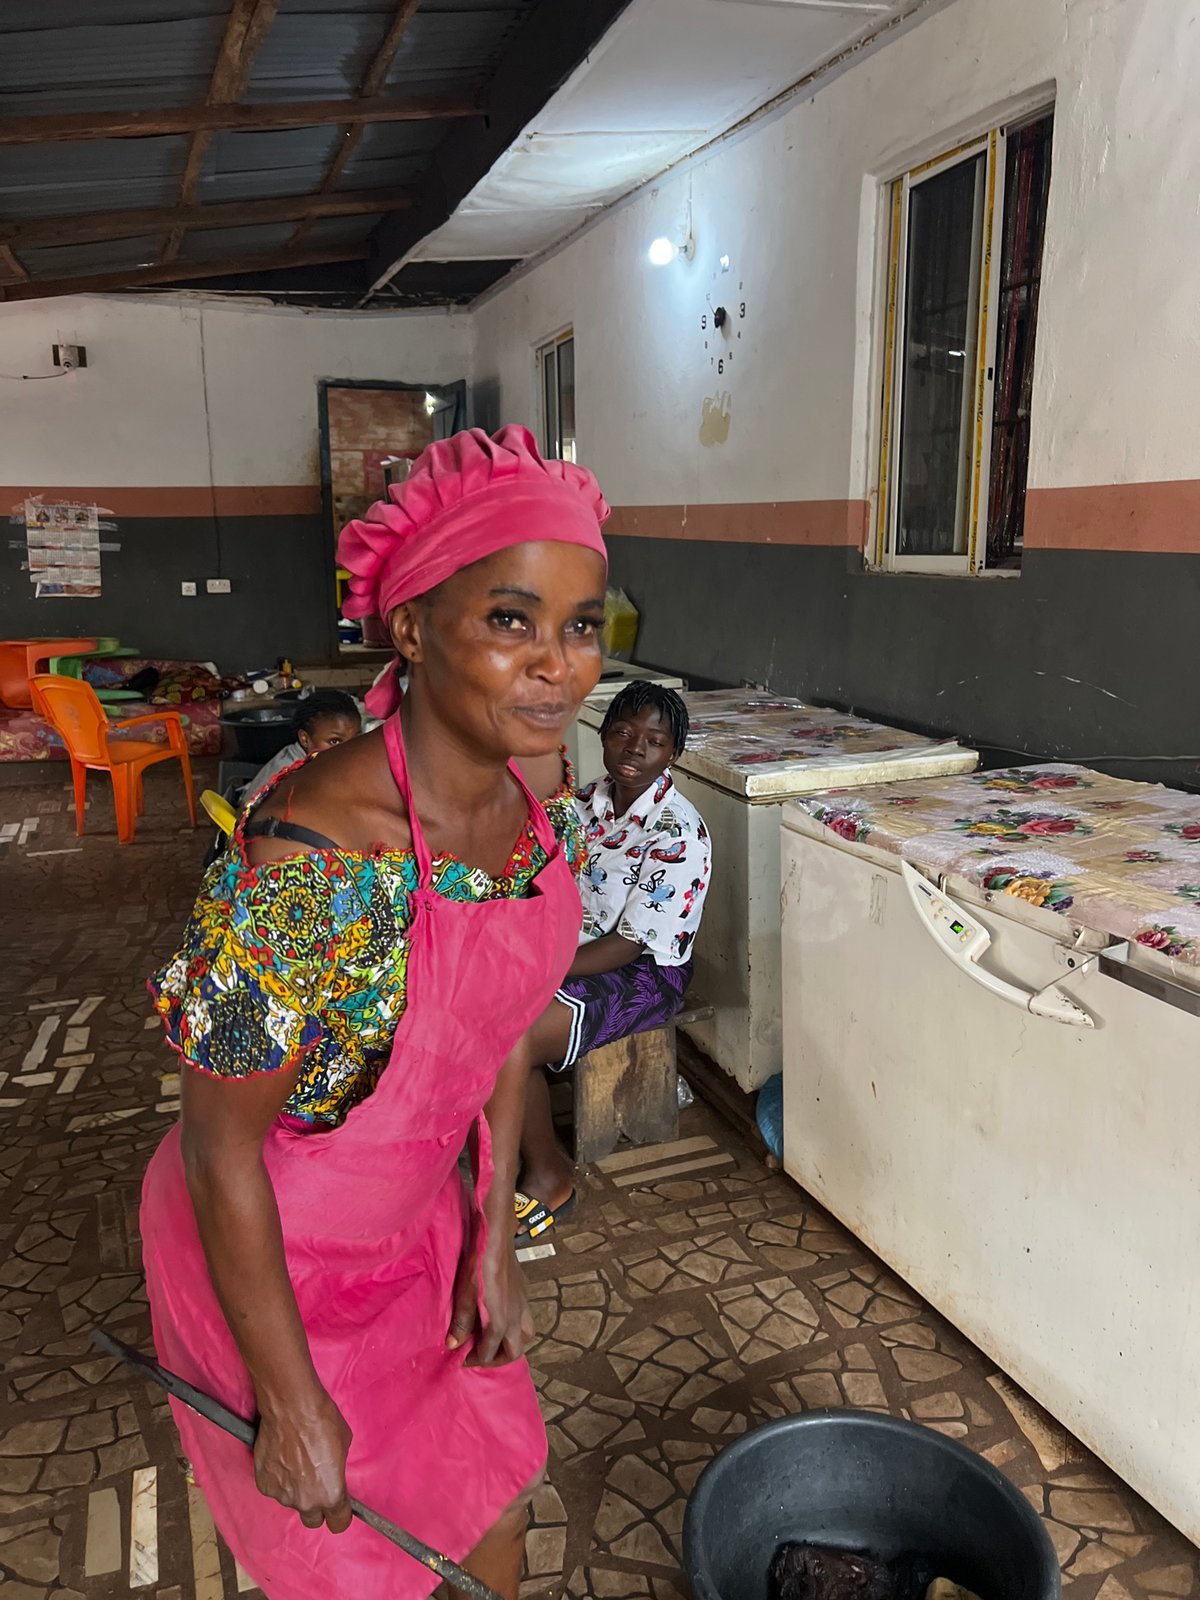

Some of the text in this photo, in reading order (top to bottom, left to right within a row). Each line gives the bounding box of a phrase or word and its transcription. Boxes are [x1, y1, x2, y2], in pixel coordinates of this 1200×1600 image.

[739, 302, 746, 318] 3
[701, 314, 707, 330] 9
[717, 358, 724, 374] 6
[528, 1210, 546, 1224] GUCCI
